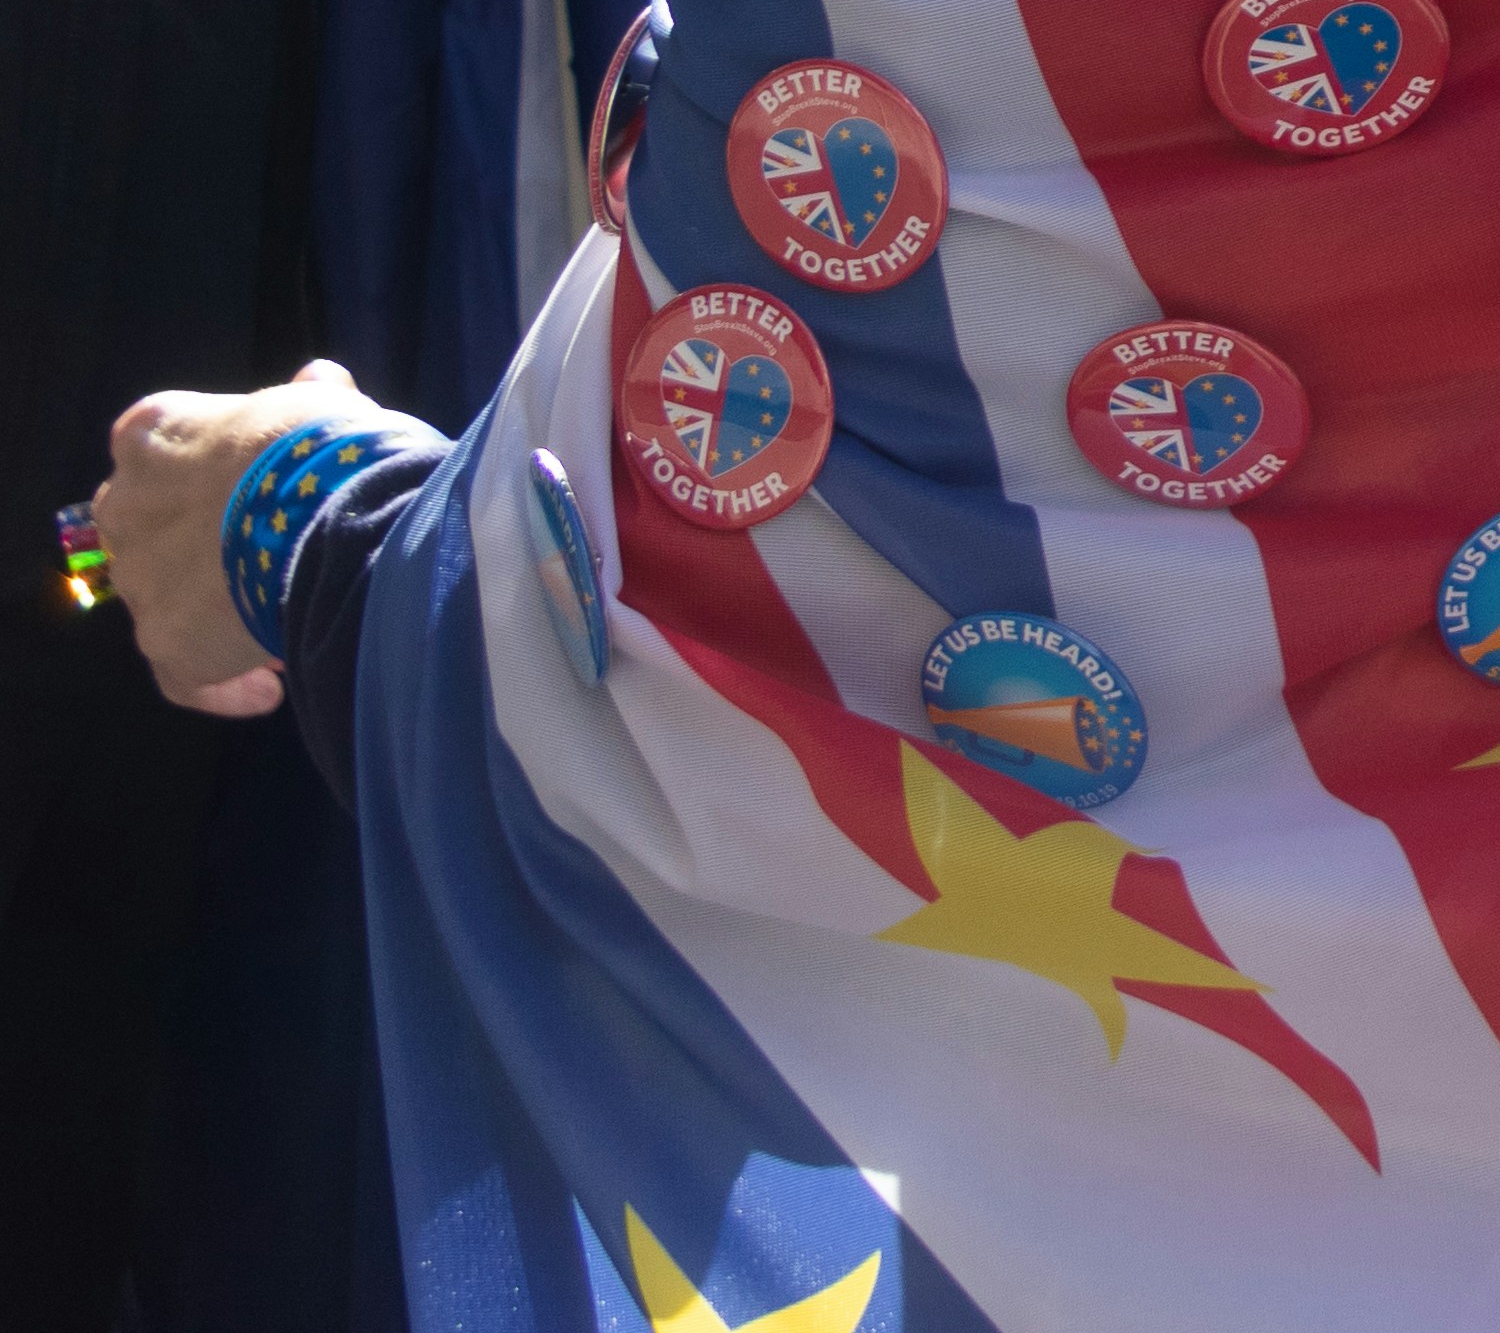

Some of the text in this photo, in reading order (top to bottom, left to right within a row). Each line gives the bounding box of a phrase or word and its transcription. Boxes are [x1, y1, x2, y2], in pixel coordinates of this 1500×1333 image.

[757, 69, 862, 115] BETTER
[1271, 75, 1435, 148] TOGETHER
[783, 215, 931, 283] TOGETHER
[690, 291, 793, 344] BETTER
[1112, 331, 1235, 365] BETTER
[641, 437, 790, 516] TOGETHER
[1117, 453, 1288, 501] TOGETHER
[1450, 546, 1487, 582] US
[1444, 585, 1470, 633] LET
[924, 619, 1124, 701] LET US BE HEARD!
